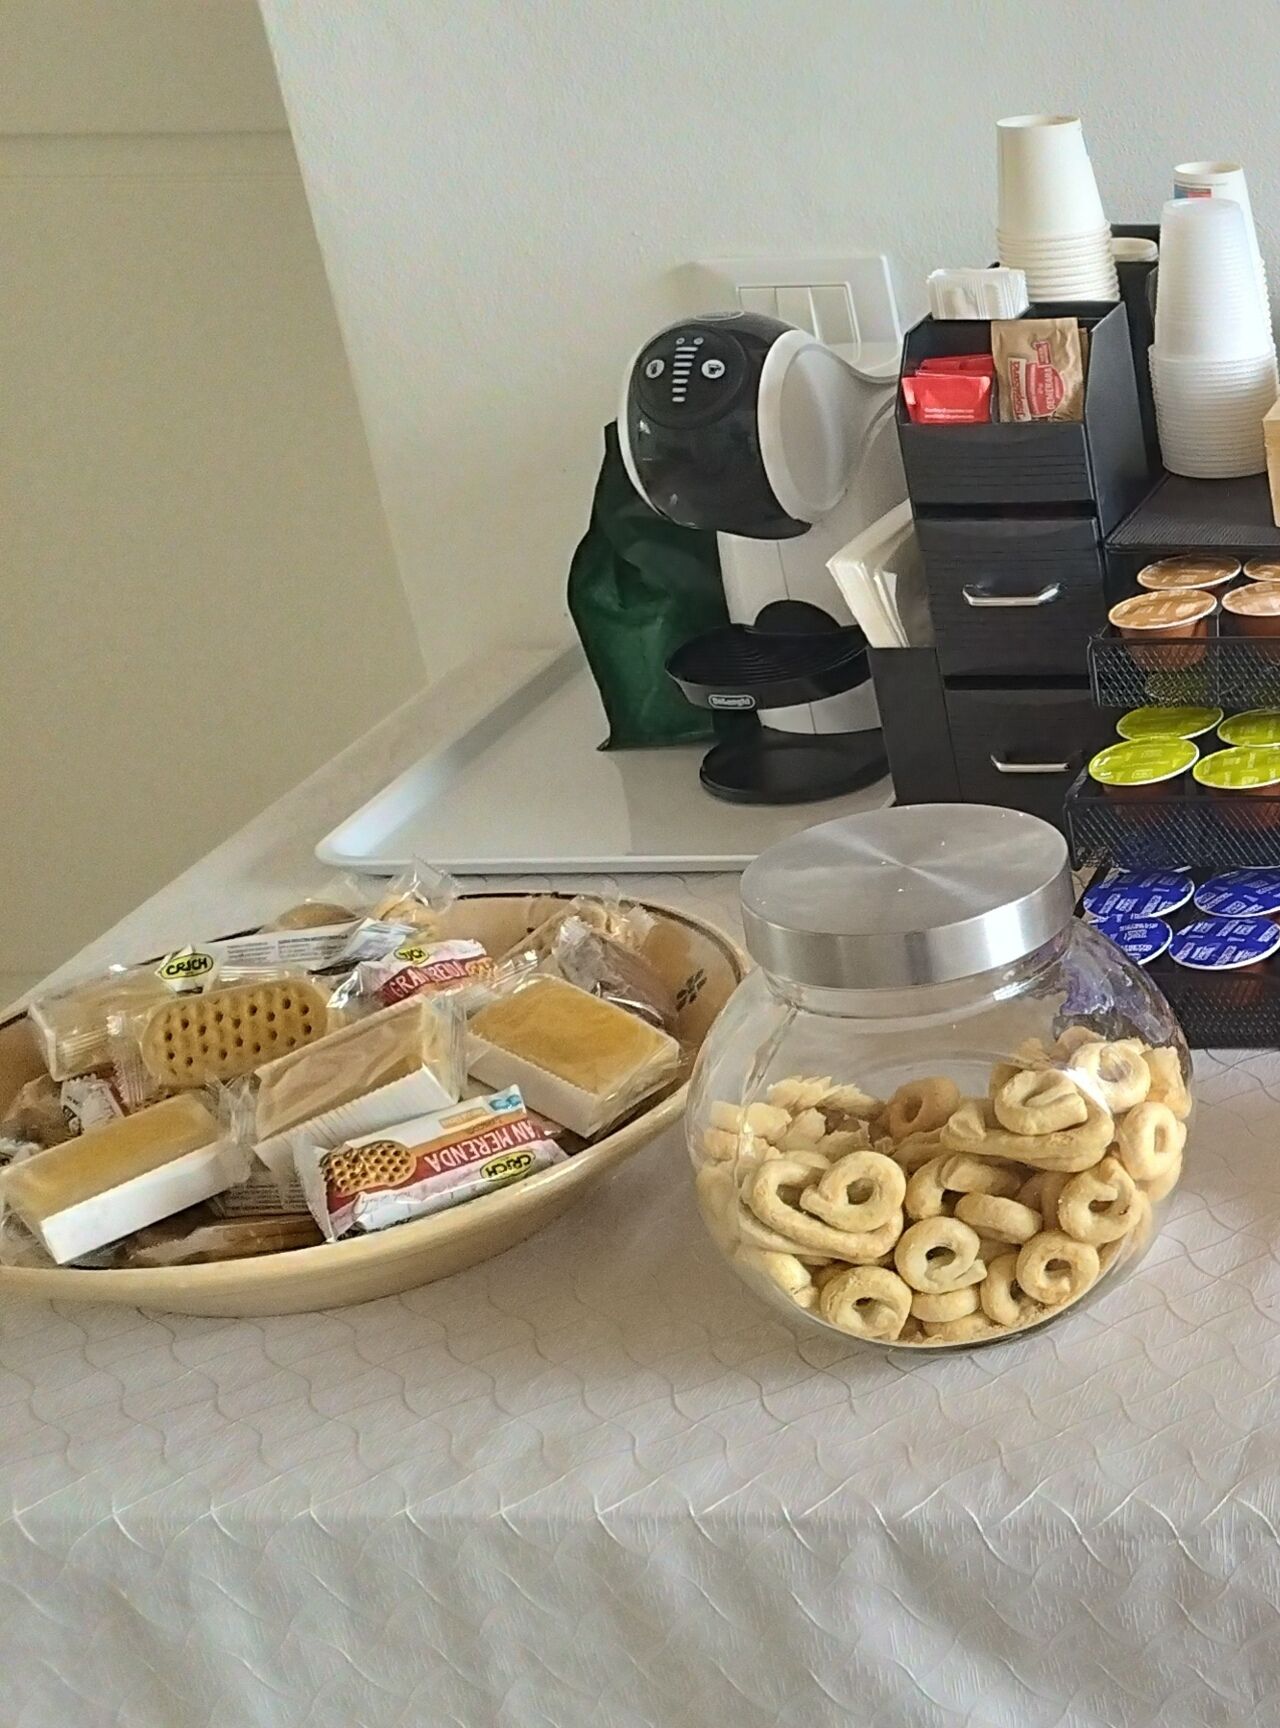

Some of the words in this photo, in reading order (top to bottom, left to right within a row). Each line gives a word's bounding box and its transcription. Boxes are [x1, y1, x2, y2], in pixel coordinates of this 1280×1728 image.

[165, 957, 208, 976] CRICH
[423, 1124, 512, 1173] MERENDA
[485, 1154, 533, 1178] CRICH
